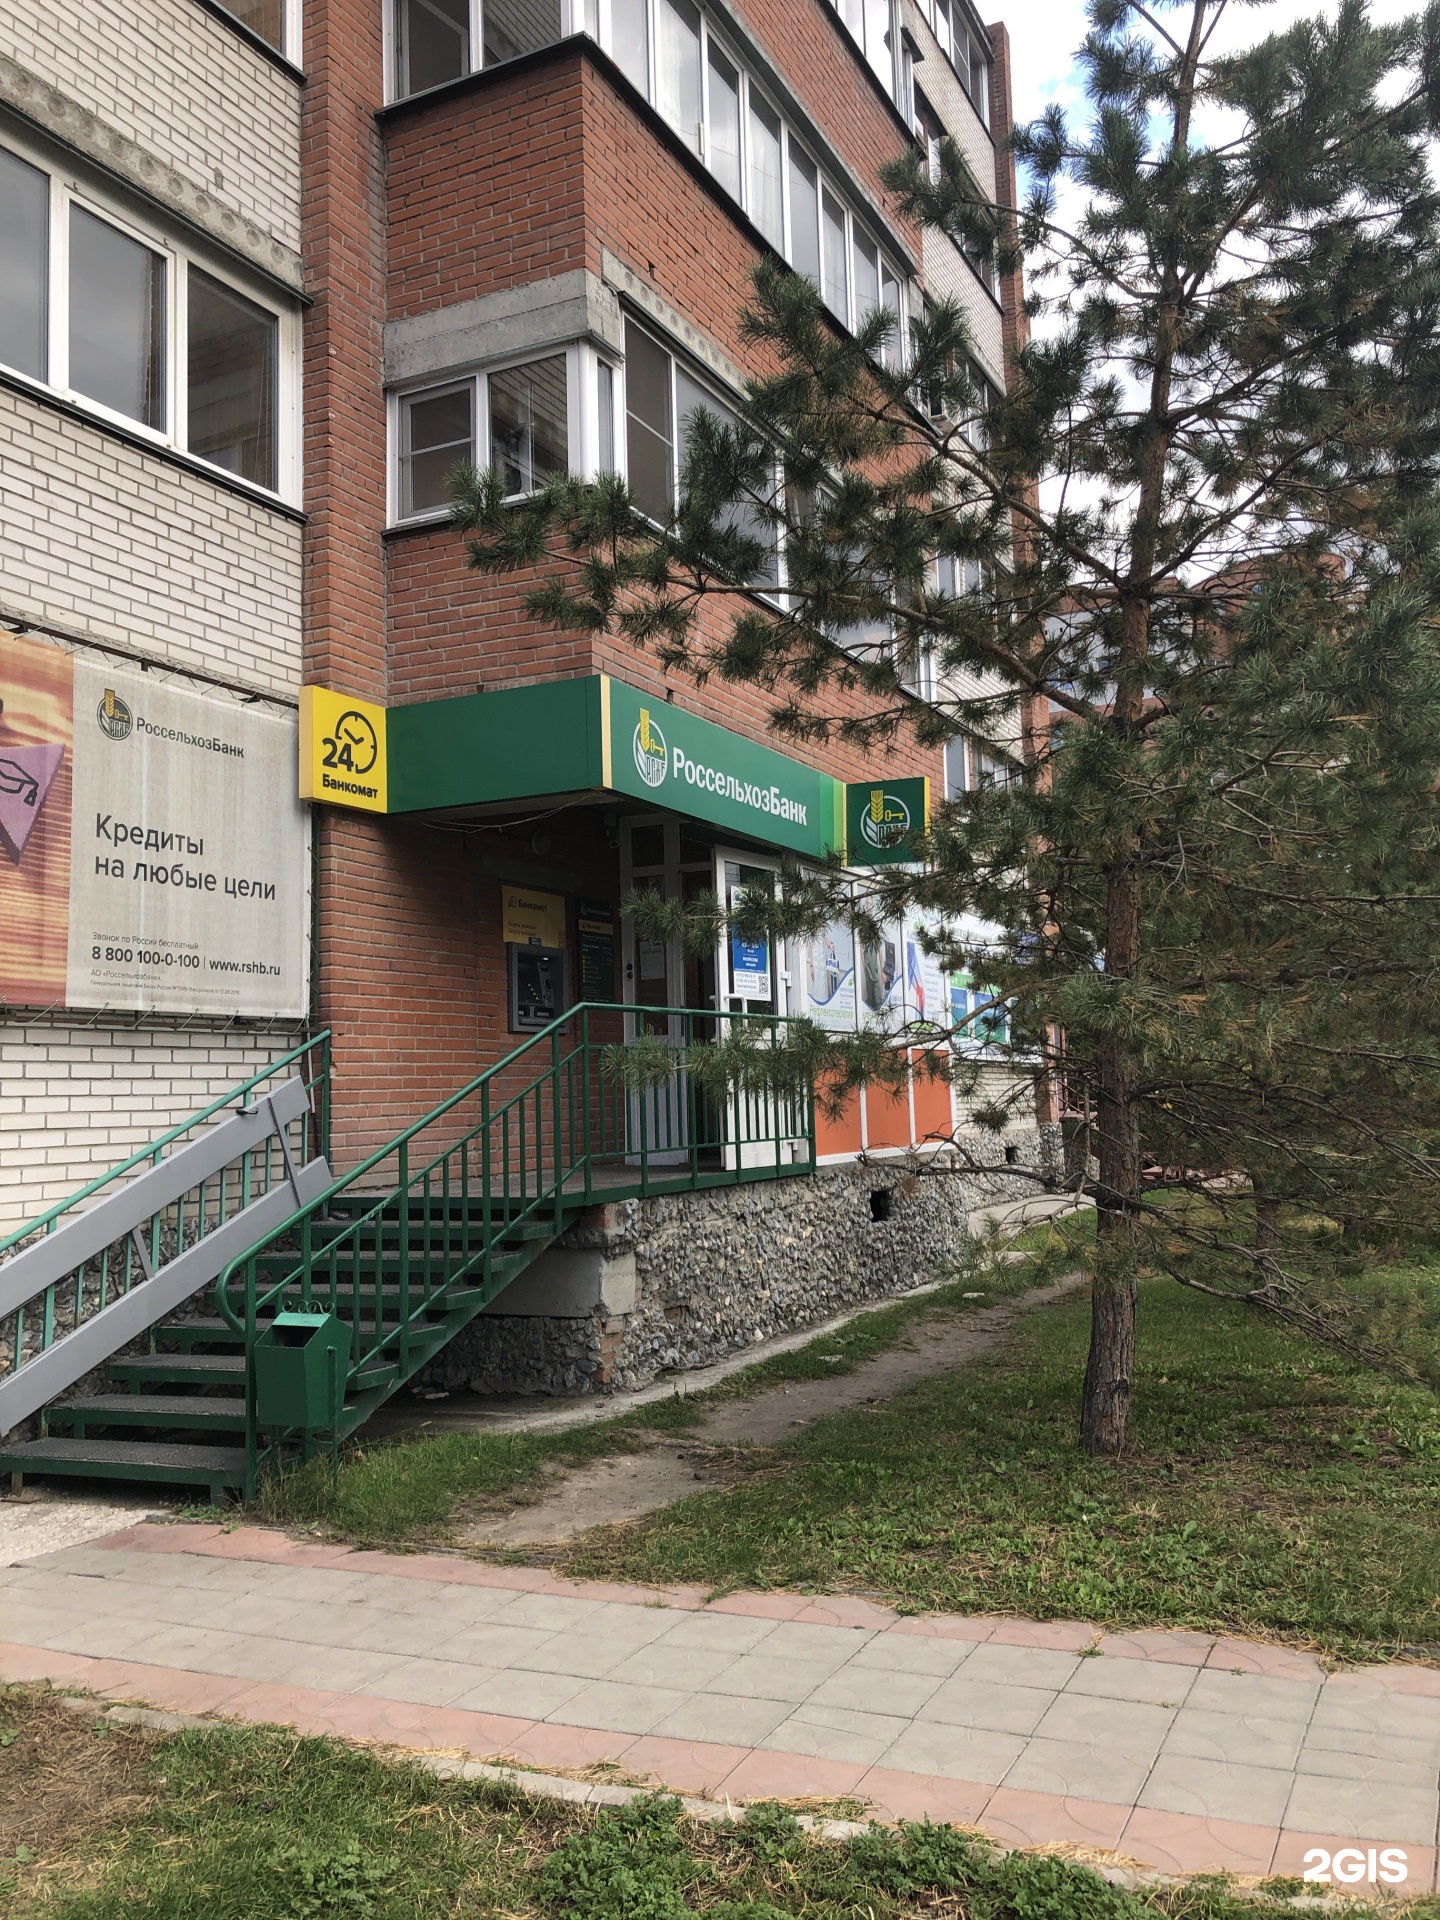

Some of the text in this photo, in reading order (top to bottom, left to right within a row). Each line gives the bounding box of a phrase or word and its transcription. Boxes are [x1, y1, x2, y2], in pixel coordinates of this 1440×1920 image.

[136, 717, 245, 759] РоссельхозБанк
[322, 737, 354, 772] 24
[322, 773, 378, 799] Банкомат
[673, 747, 808, 826] РоссельхозБанк
[96, 812, 204, 856] Кредиты
[95, 856, 276, 901] на любые цели
[518, 899, 547, 912] Банкомат
[92, 932, 199, 950] Звонок по России бесплатный
[92, 946, 281, 976] 8 800 100-0-100 www.rshb.ru
